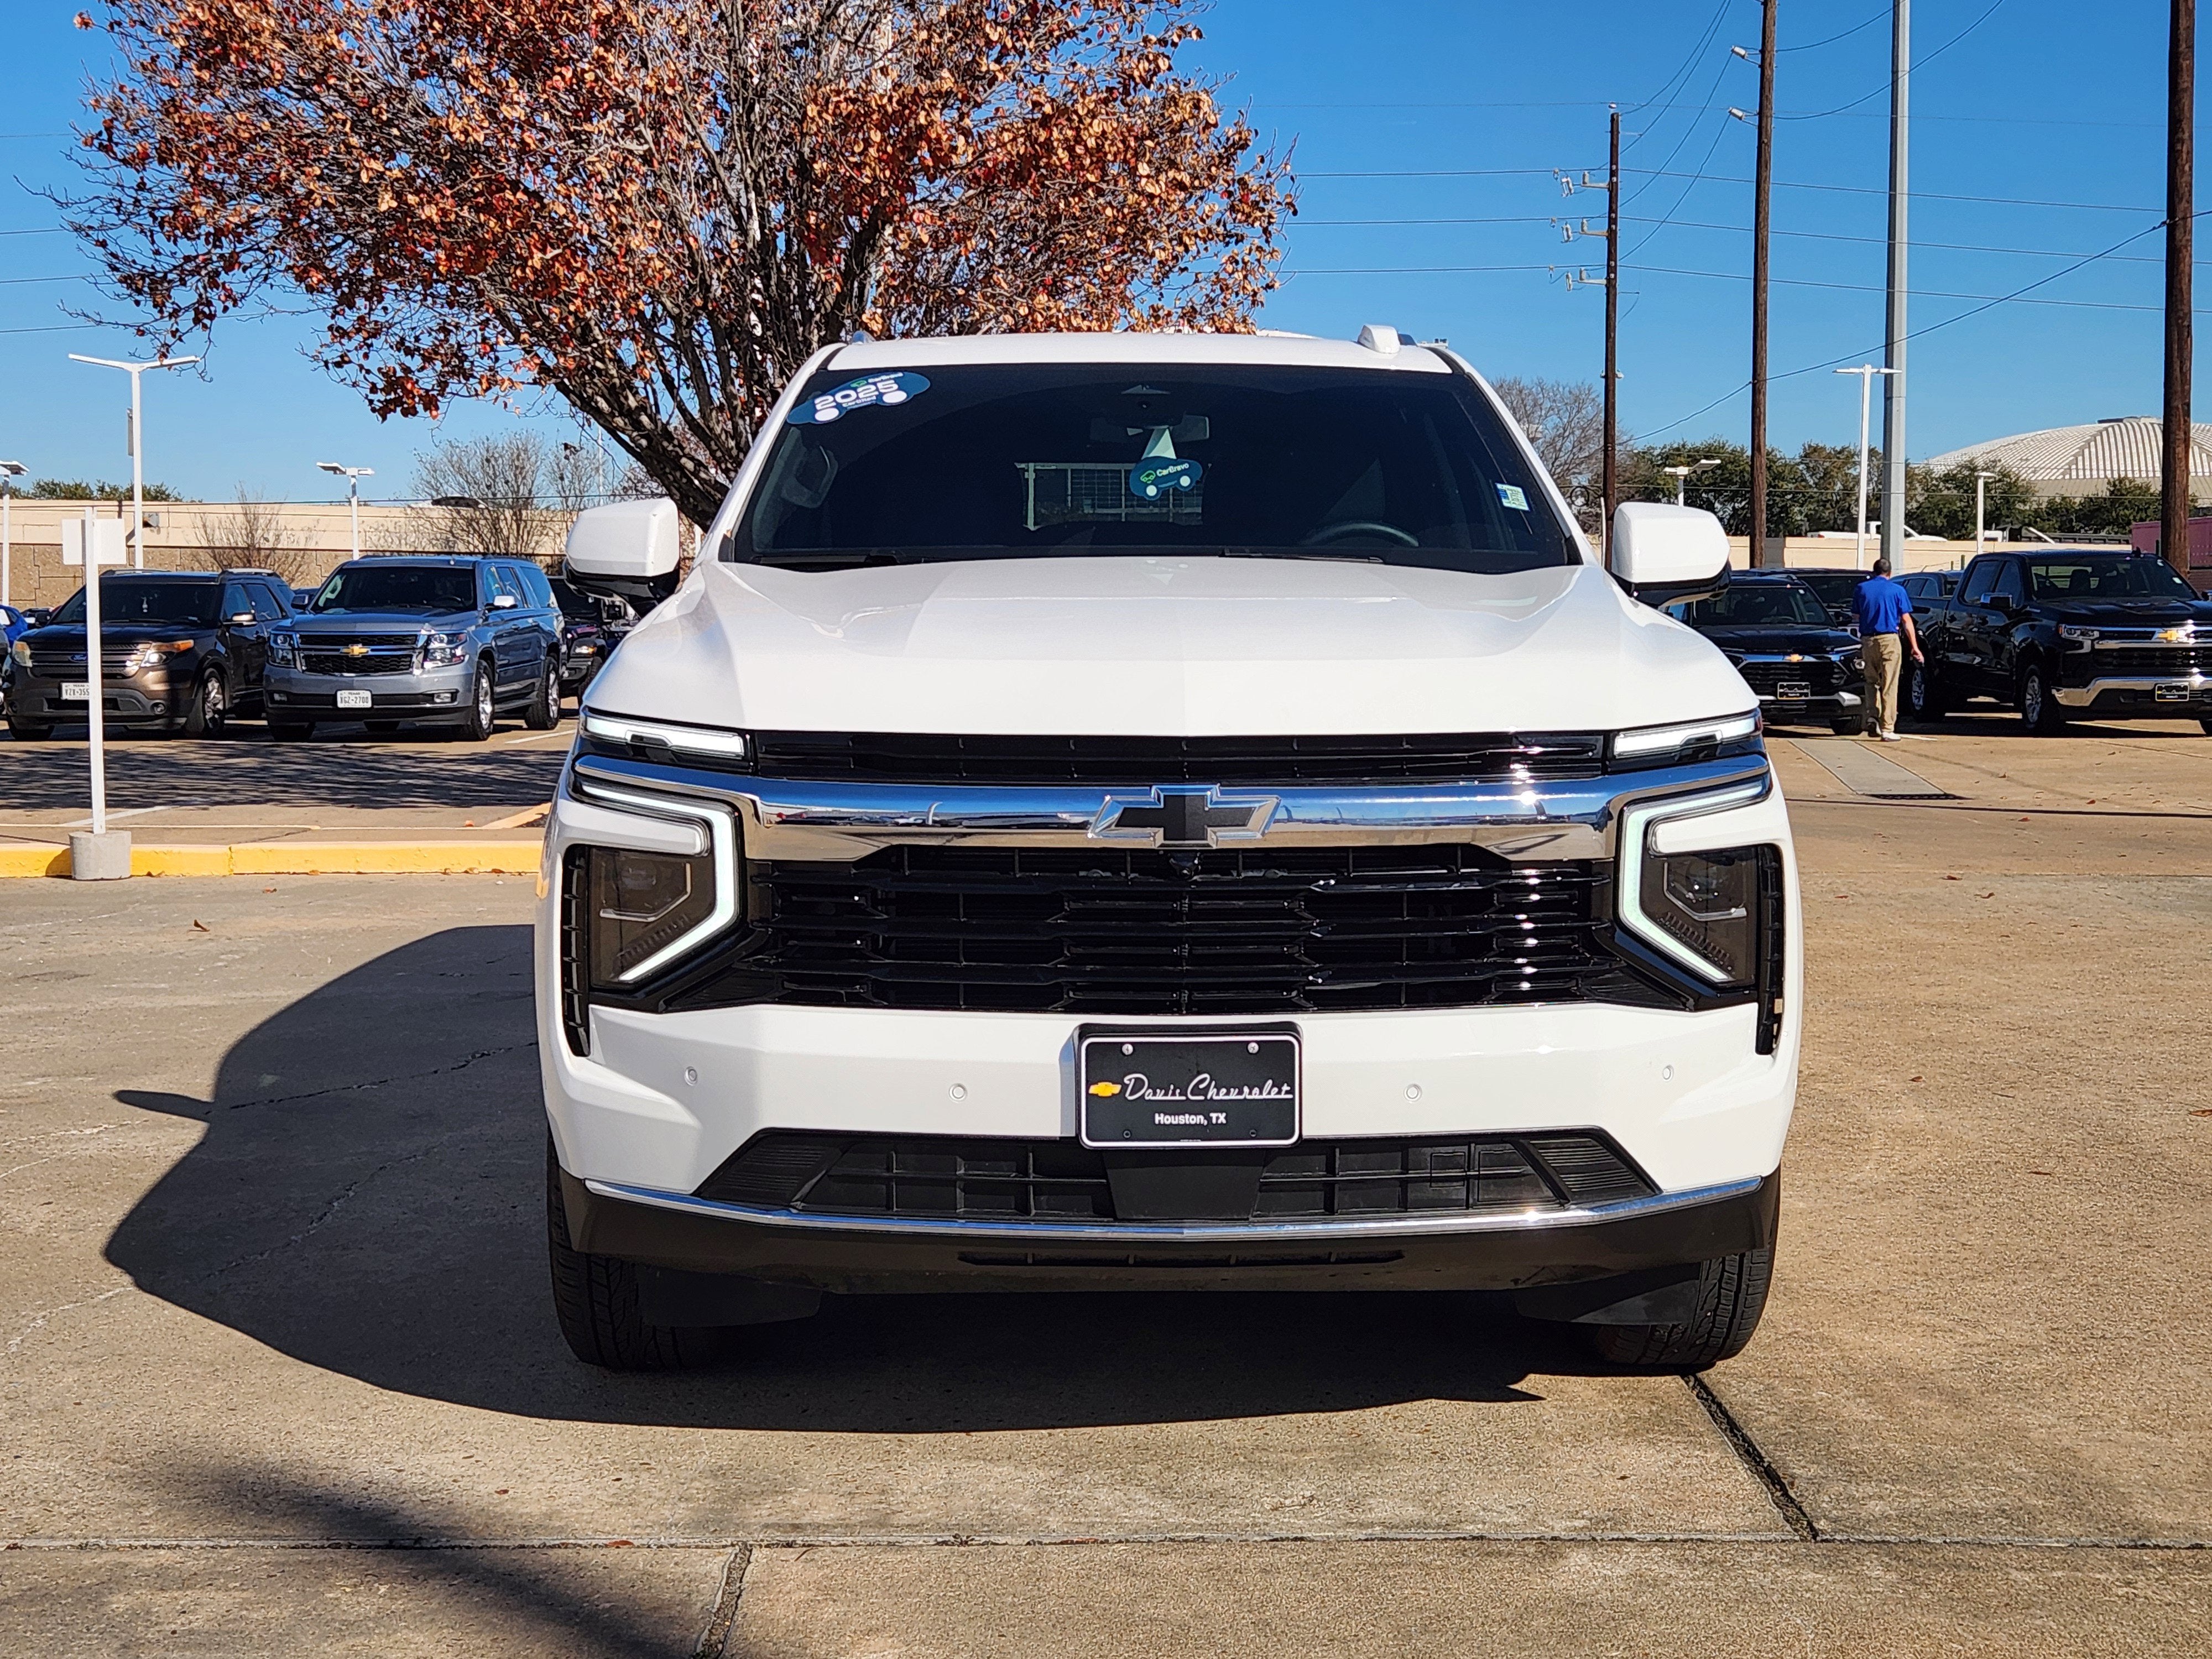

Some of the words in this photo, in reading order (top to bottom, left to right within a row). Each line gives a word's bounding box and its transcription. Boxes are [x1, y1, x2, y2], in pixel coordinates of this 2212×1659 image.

[814, 379, 899, 410] 2025
[1156, 462, 1190, 477] CarBravo
[1124, 1073, 1186, 1100] Davis
[1187, 1073, 1293, 1100] Chevrolet
[1155, 1113, 1208, 1126] Houston,
[1209, 1112, 1227, 1124] TX
